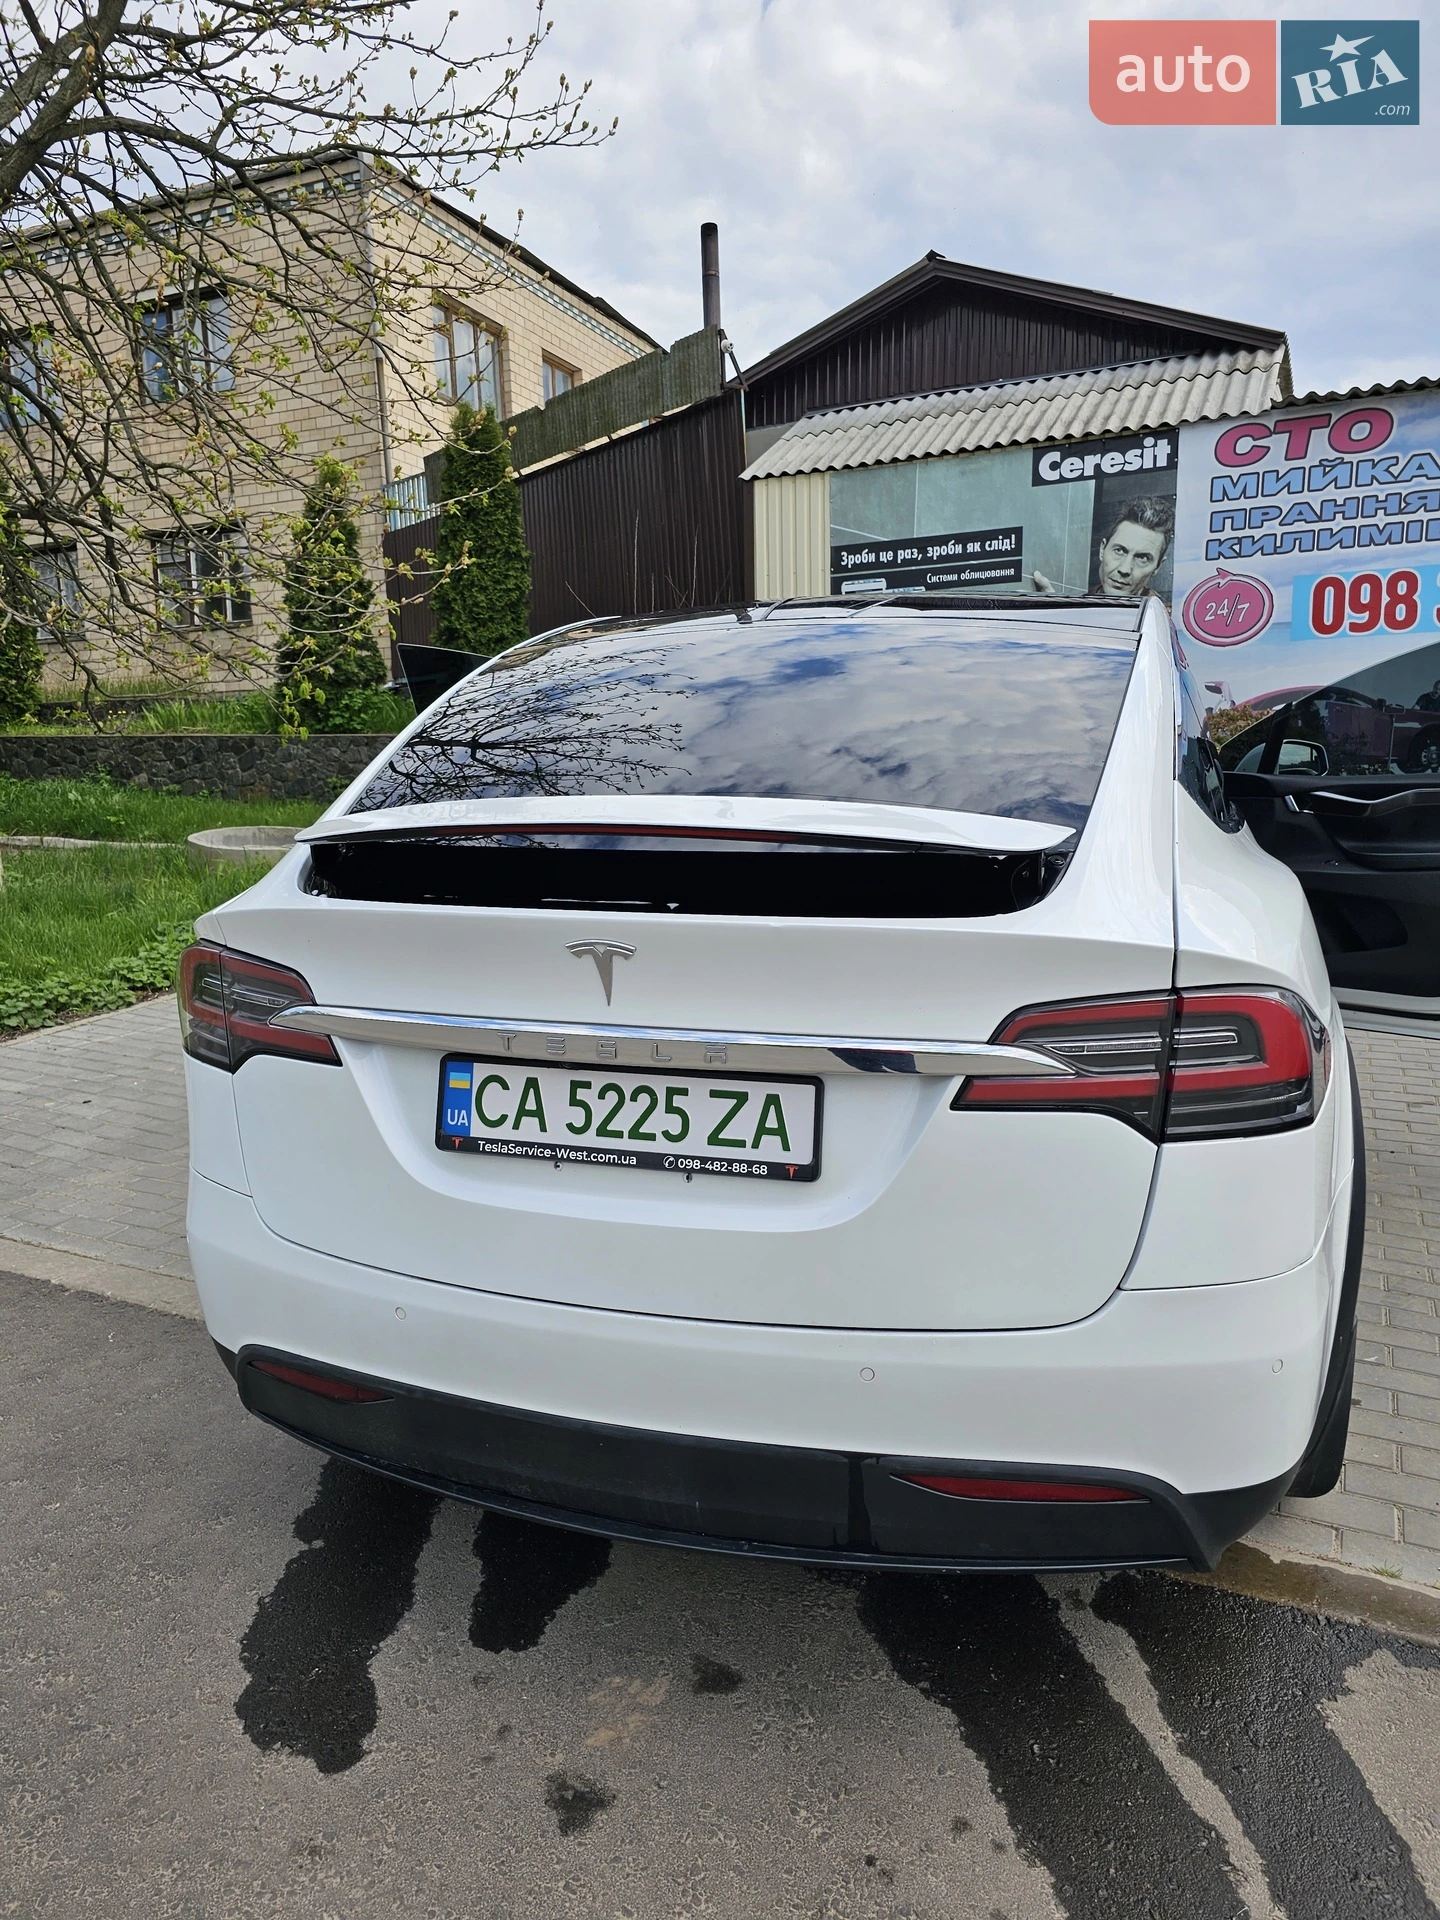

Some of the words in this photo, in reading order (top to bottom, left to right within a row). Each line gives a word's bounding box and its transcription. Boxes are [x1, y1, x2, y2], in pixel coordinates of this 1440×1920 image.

[1214, 407, 1394, 467] СТО
[1038, 436, 1171, 481] Ceresit
[1210, 452, 1440, 503] МИЙКА
[1209, 488, 1440, 533] ПРАННЯ
[840, 550, 876, 568] Зроби
[879, 550, 894, 564] це
[897, 547, 923, 564] раз,
[926, 540, 963, 561] зроби
[966, 542, 982, 554] як
[985, 534, 1016, 552] слід!
[926, 572, 958, 584] Системи
[960, 567, 1015, 582] облицювання
[1204, 593, 1251, 627] 24/7
[1310, 569, 1420, 637] 098
[497, 1032, 727, 1065] TESLA
[447, 1108, 469, 1127] UA
[475, 1074, 548, 1133] CA
[565, 1079, 691, 1143] 5225
[707, 1089, 791, 1152] ZA
[478, 1140, 637, 1165] TeslaService-West.com.ua
[677, 1158, 768, 1176] 098-482-88-68
